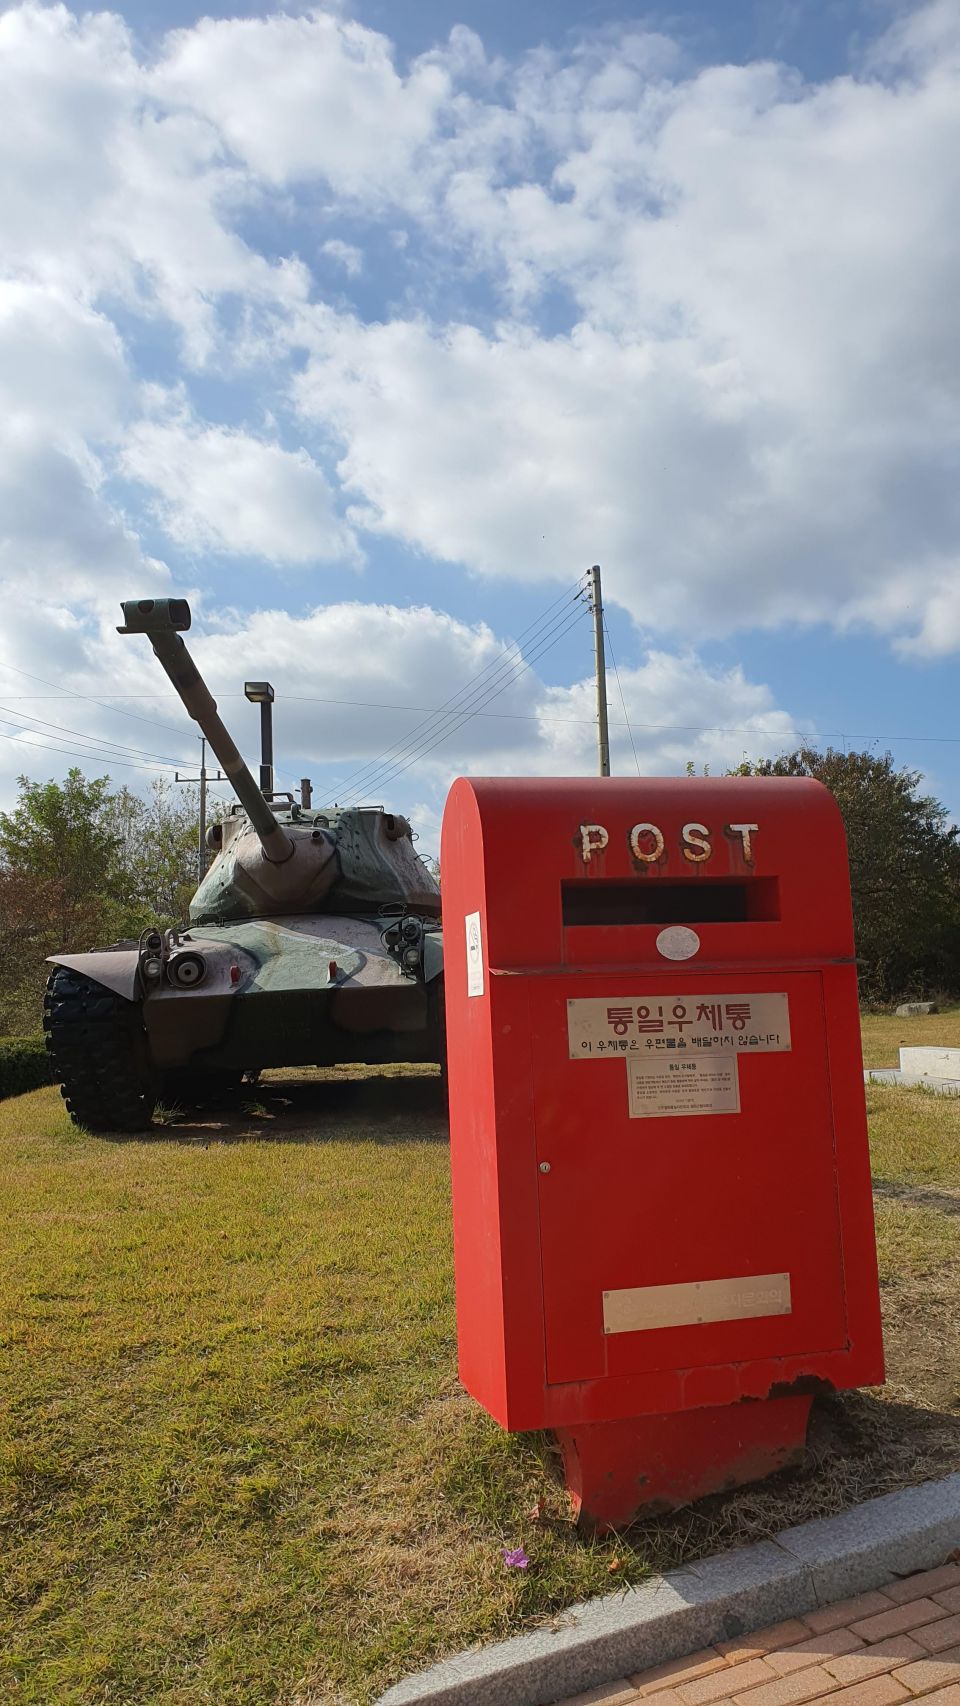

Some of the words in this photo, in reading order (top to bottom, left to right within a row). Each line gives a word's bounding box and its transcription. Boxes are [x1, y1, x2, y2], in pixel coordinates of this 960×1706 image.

[579, 822, 759, 863] POST
[607, 1003, 752, 1035] 통일우체통
[581, 1041, 592, 1052] 이
[597, 1039, 640, 1051] 우체통은
[645, 1036, 687, 1049] 우편물을
[691, 1035, 734, 1048] 배달하지
[738, 1033, 780, 1046] 않습니다
